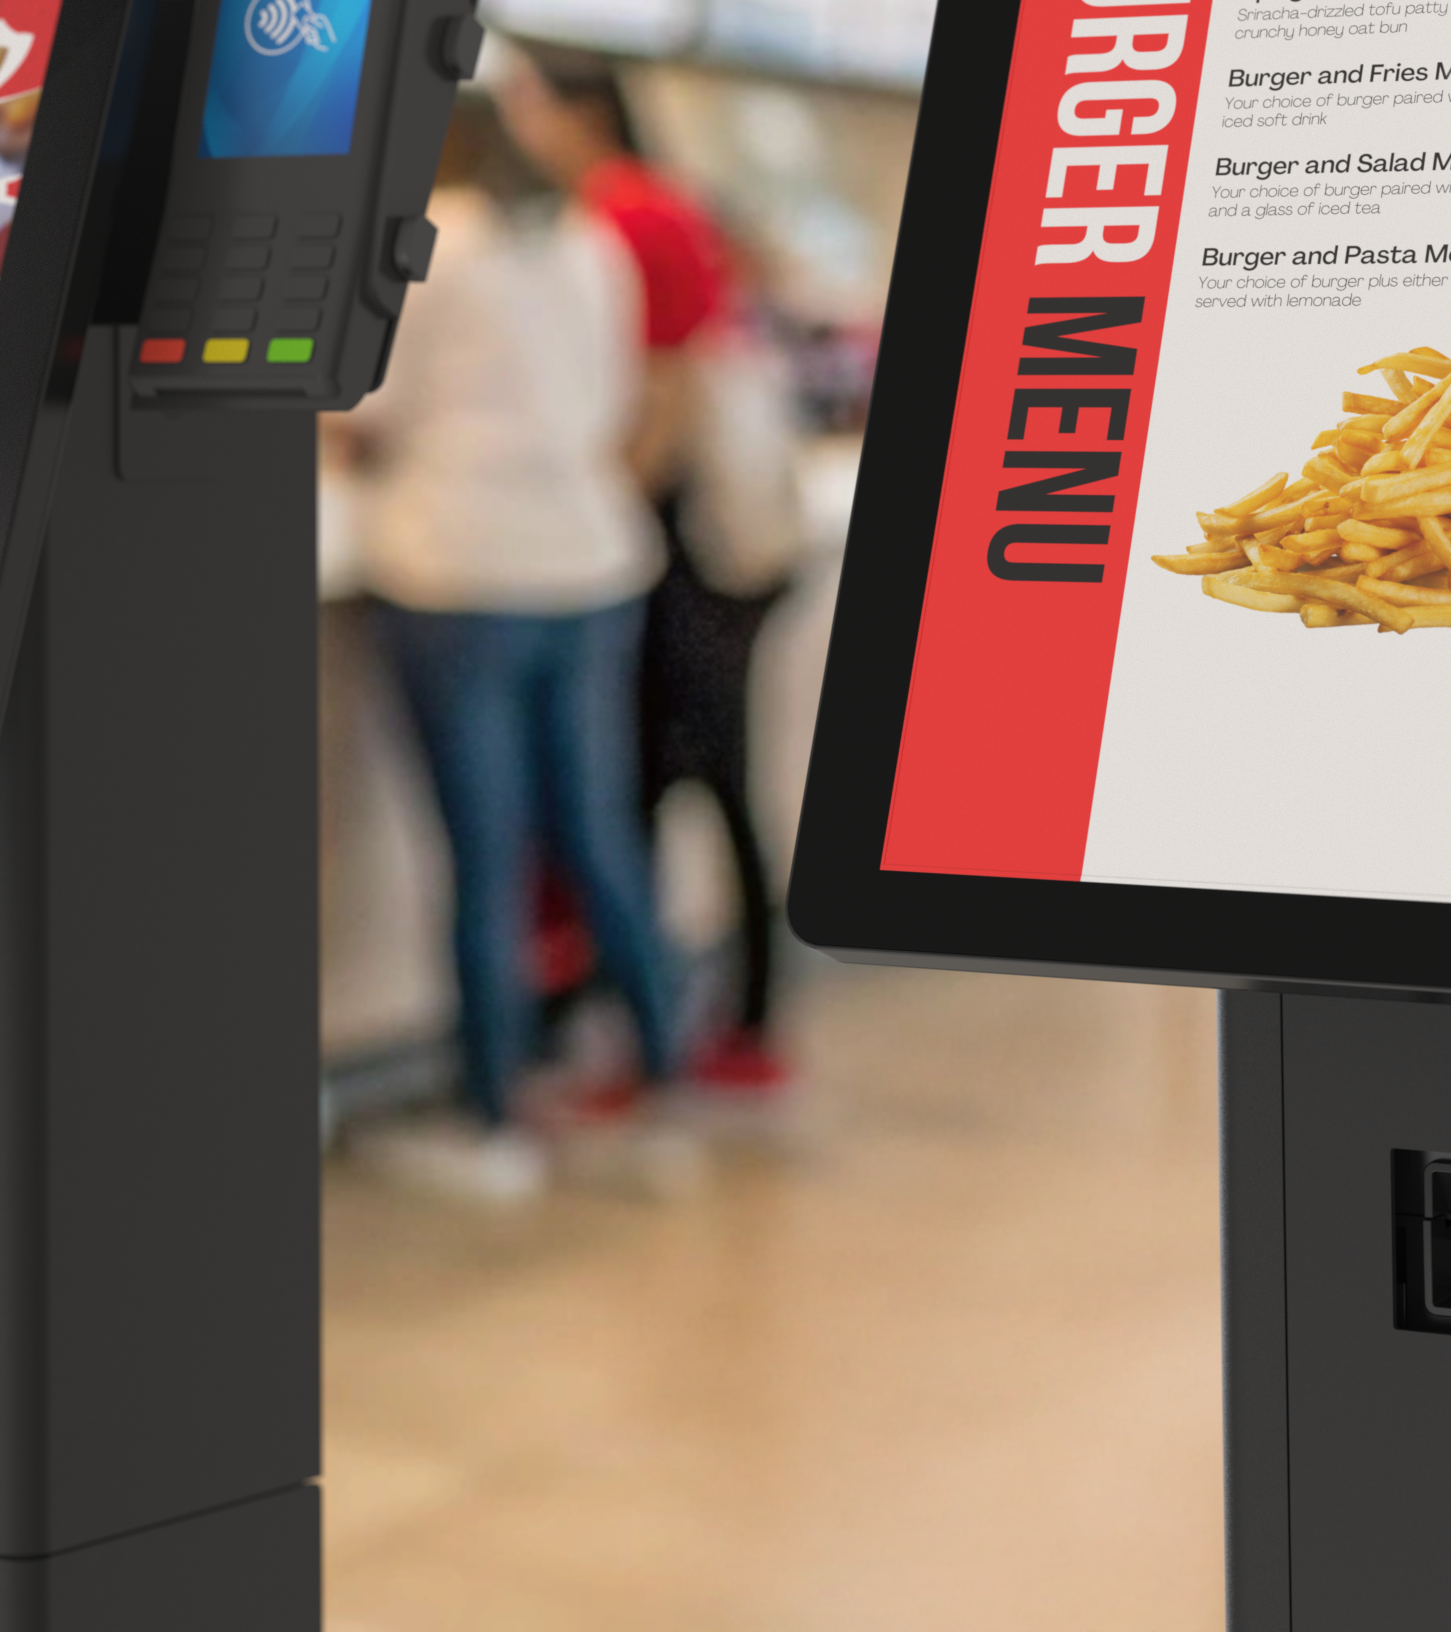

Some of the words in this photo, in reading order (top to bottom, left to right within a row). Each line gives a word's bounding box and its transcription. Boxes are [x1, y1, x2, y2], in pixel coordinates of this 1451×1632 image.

[1236, 3, 1366, 23] Sriracha-drizzled
[1368, 1, 1402, 17] tofu
[1403, 1, 1449, 18] patty
[1234, 24, 1296, 42] crunchy
[1297, 23, 1345, 40] honey
[1347, 22, 1376, 36] oat
[1378, 20, 1409, 35] bun
[1228, 68, 1313, 92] Burger
[1317, 63, 1365, 85] and
[1369, 62, 1429, 83] Fries
[1225, 96, 1259, 111] Your
[1261, 95, 1313, 110] choice
[1315, 92, 1334, 108] of
[1336, 92, 1390, 110] burger
[1392, 89, 1445, 108] paired
[1214, 157, 1300, 181] Burger
[1304, 153, 1352, 175] and
[1356, 151, 1427, 174] Salad
[1201, 247, 1287, 272] Burger
[1291, 244, 1339, 266] and
[1344, 245, 1418, 265] Pasta
[1198, 276, 1233, 290] Your
[1235, 275, 1287, 290] choice
[1289, 273, 1309, 289] of
[1310, 274, 1365, 292] burger
[1367, 273, 1399, 291] plus
[1401, 272, 1449, 288] either
[985, 296, 1147, 584] MENU
